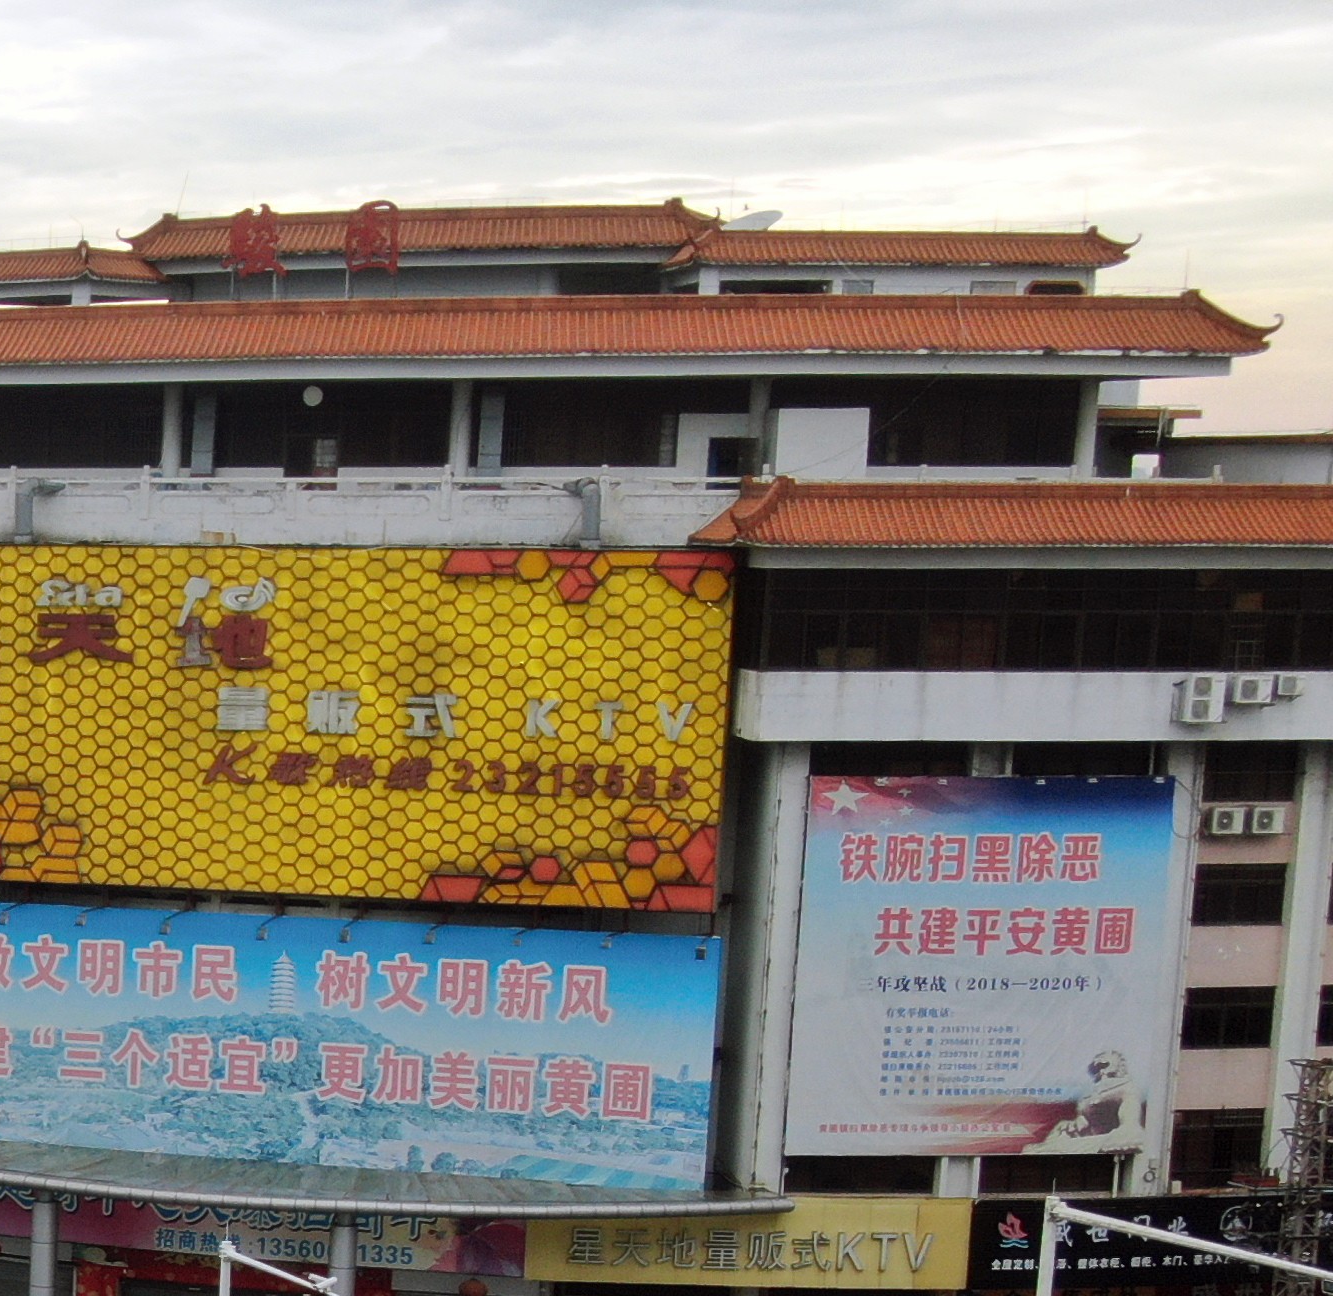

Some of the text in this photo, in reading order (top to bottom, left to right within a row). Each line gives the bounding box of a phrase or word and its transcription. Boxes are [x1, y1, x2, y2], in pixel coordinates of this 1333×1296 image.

[839, 833, 1101, 883] 铁腕扫黑除恶
[874, 905, 1136, 957] 共建平安黄圃
[316, 950, 612, 1025] 树文明新风
[567, 1227, 934, 1273] 星天地量贩式KTV
